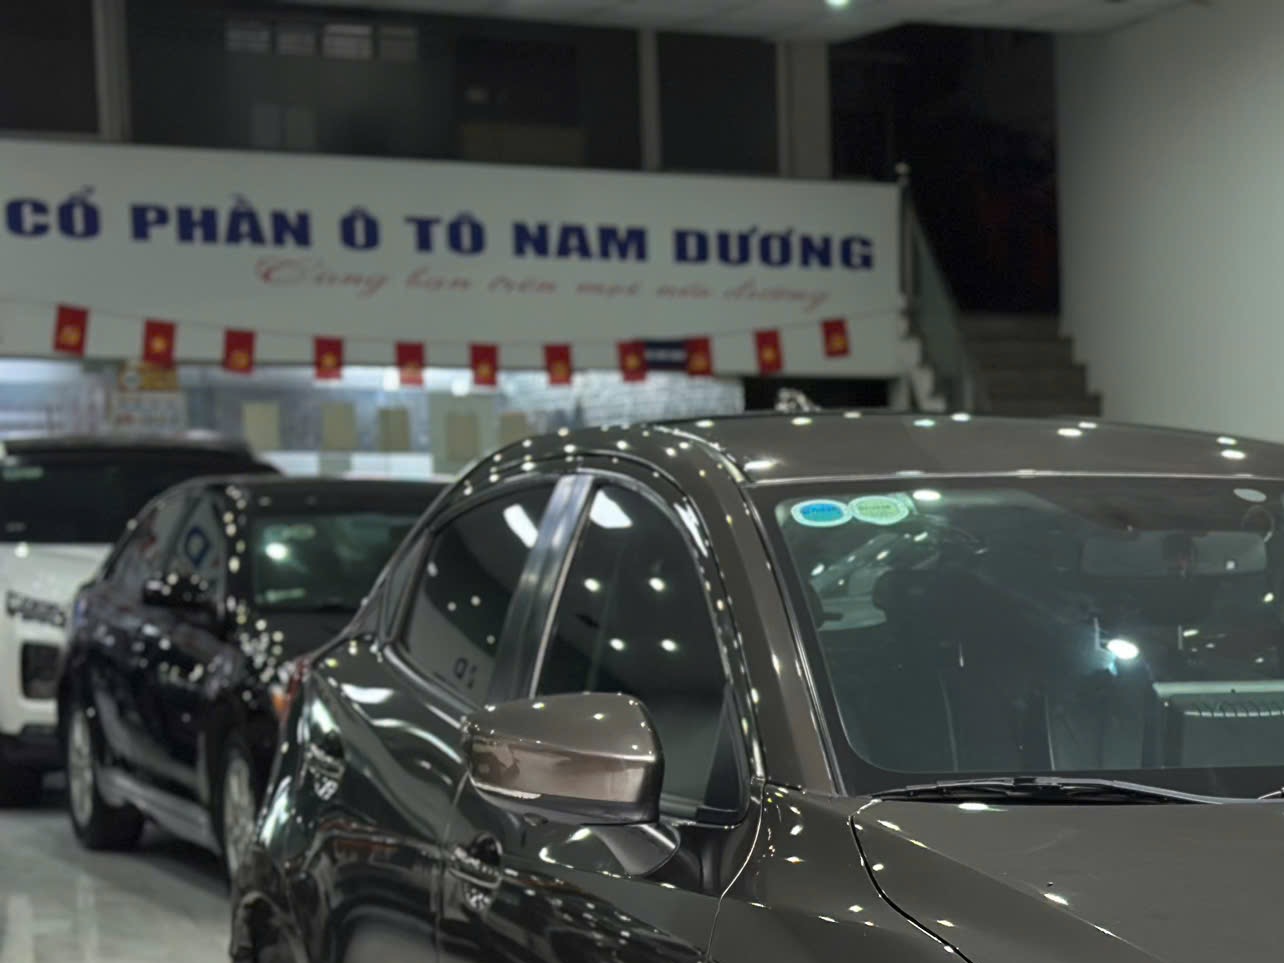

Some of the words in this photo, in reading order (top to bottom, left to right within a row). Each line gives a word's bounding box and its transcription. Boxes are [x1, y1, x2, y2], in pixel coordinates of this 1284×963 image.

[5, 185, 102, 239] CỔ
[129, 193, 312, 247] PHẦN
[339, 206, 380, 251] Ô
[405, 211, 486, 256] TÔ
[511, 222, 648, 262] NAM
[672, 225, 875, 270] DƯƠNG
